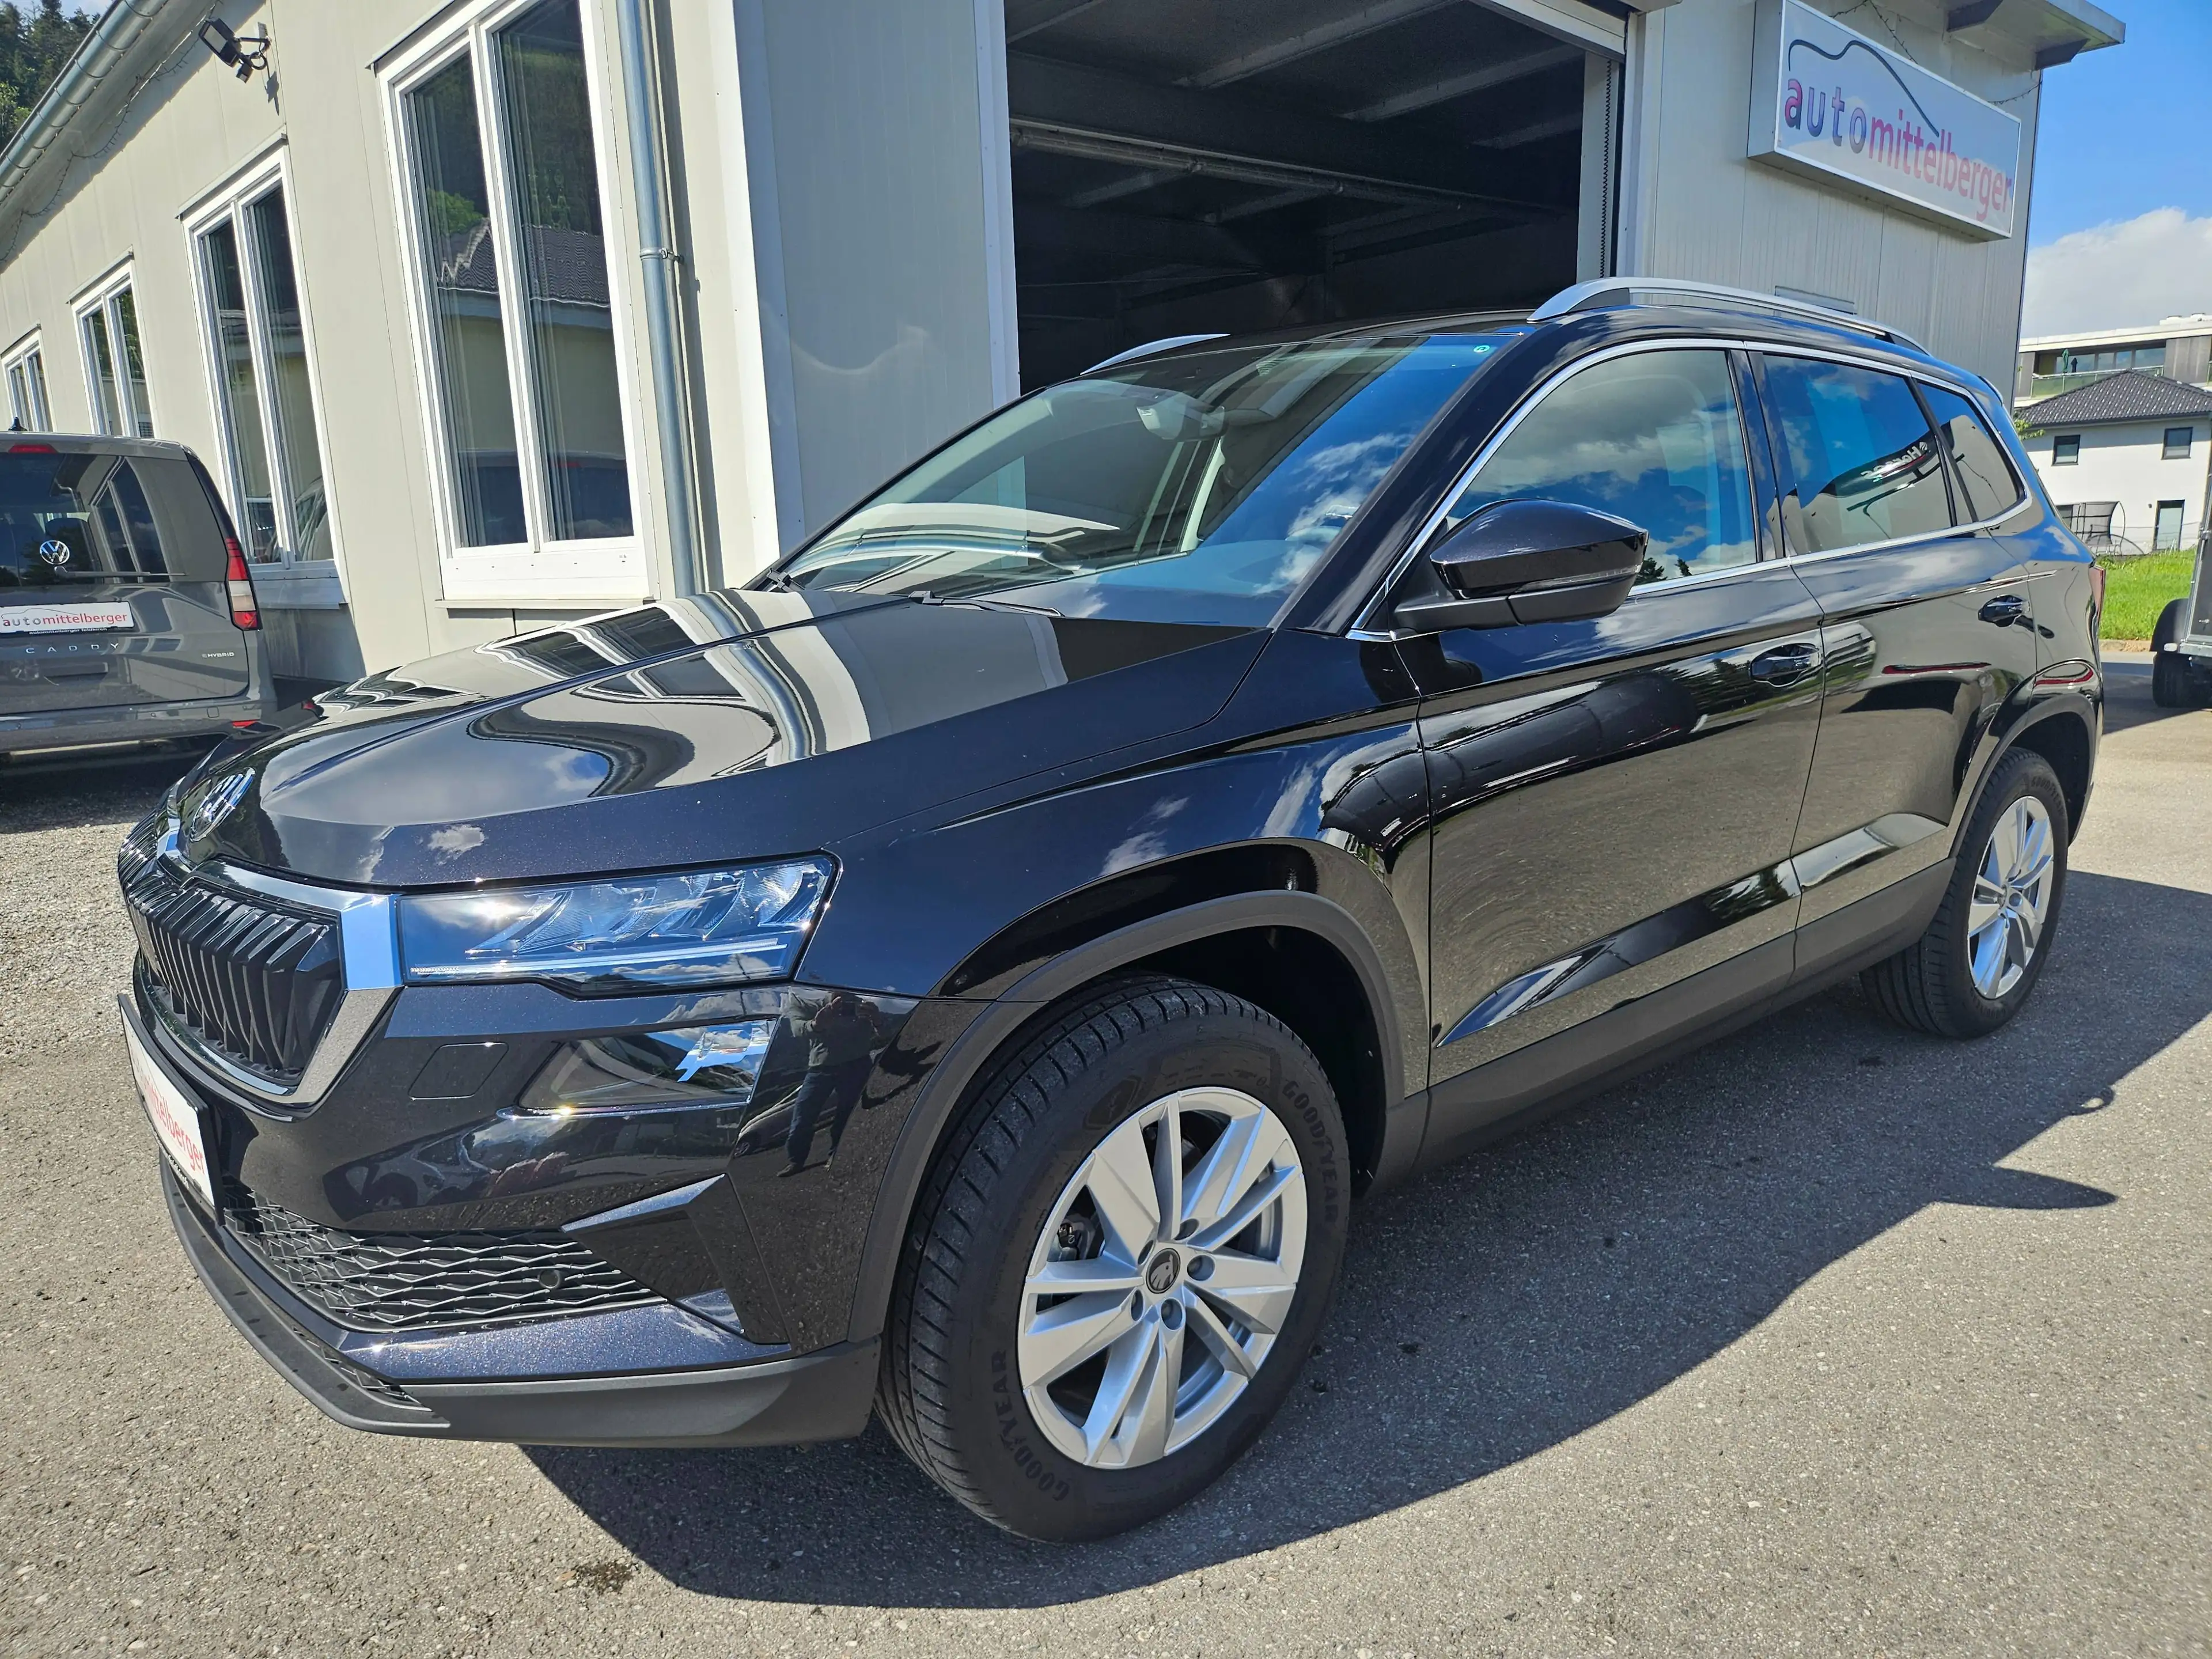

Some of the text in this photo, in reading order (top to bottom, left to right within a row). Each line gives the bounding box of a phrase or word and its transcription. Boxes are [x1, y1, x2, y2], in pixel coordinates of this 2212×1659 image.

[1785, 78, 2013, 221] automittelberger
[3, 613, 127, 627] automittelberger
[25, 643, 119, 654] CADDY
[1282, 1080, 1339, 1223] GOODYEAR
[991, 1350, 1070, 1502] GOODYEAR
